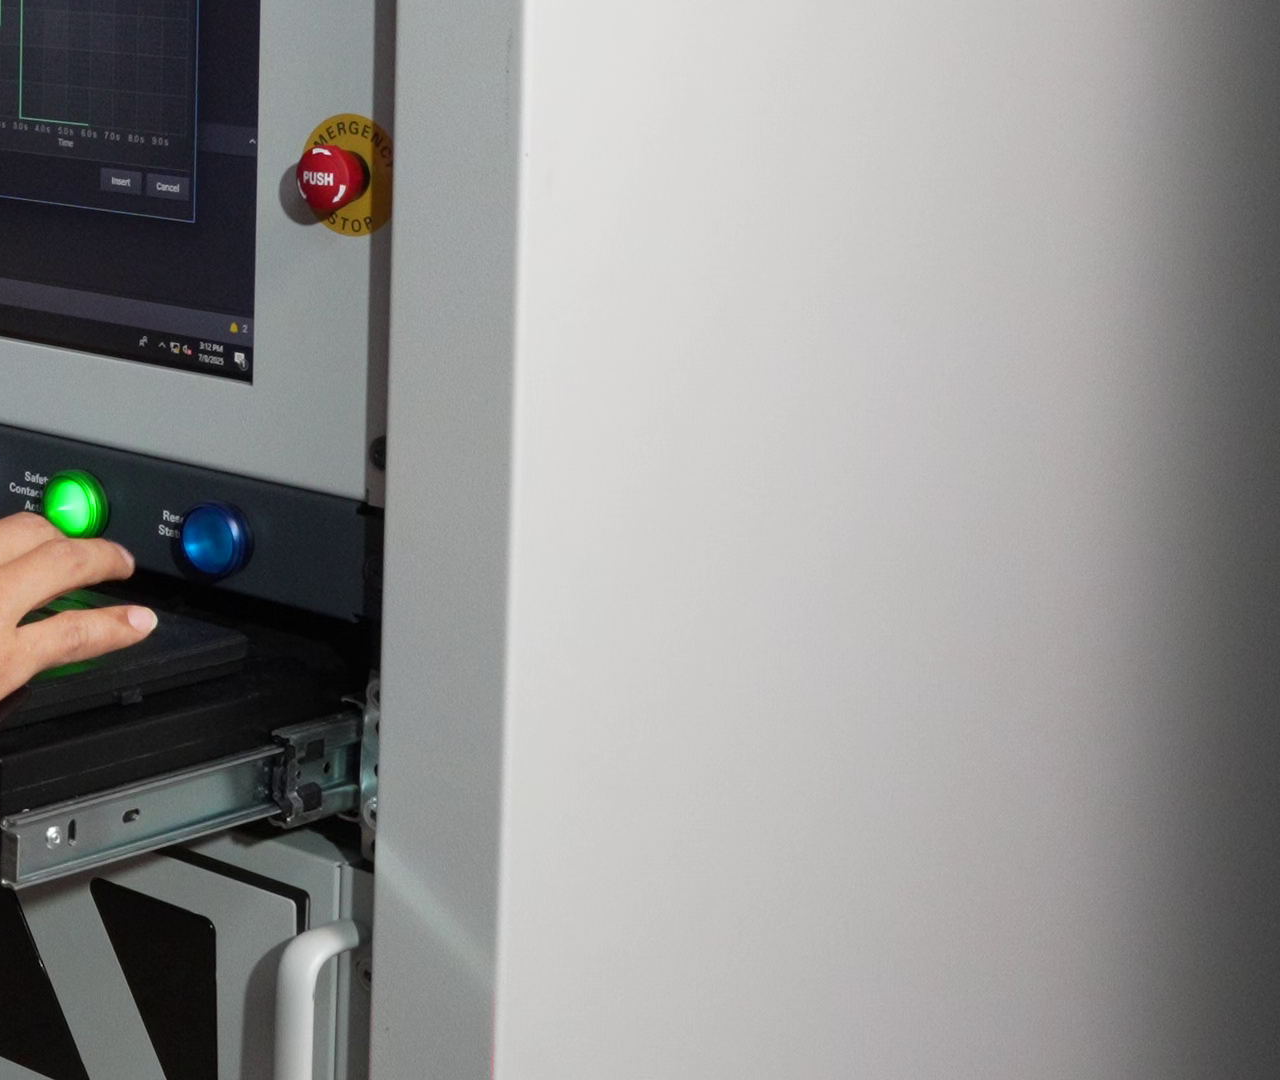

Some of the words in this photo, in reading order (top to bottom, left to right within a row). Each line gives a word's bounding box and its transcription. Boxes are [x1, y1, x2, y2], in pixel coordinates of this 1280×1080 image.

[58, 138, 74, 148] Time
[313, 121, 393, 168] MERGENC
[111, 176, 131, 186] Insert
[303, 171, 334, 186] PUSH
[156, 182, 180, 192] Cancel
[242, 324, 248, 333] 2
[200, 342, 212, 351] 3:12
[212, 343, 224, 353] PM
[24, 471, 49, 485] Safet
[162, 510, 184, 524] Res
